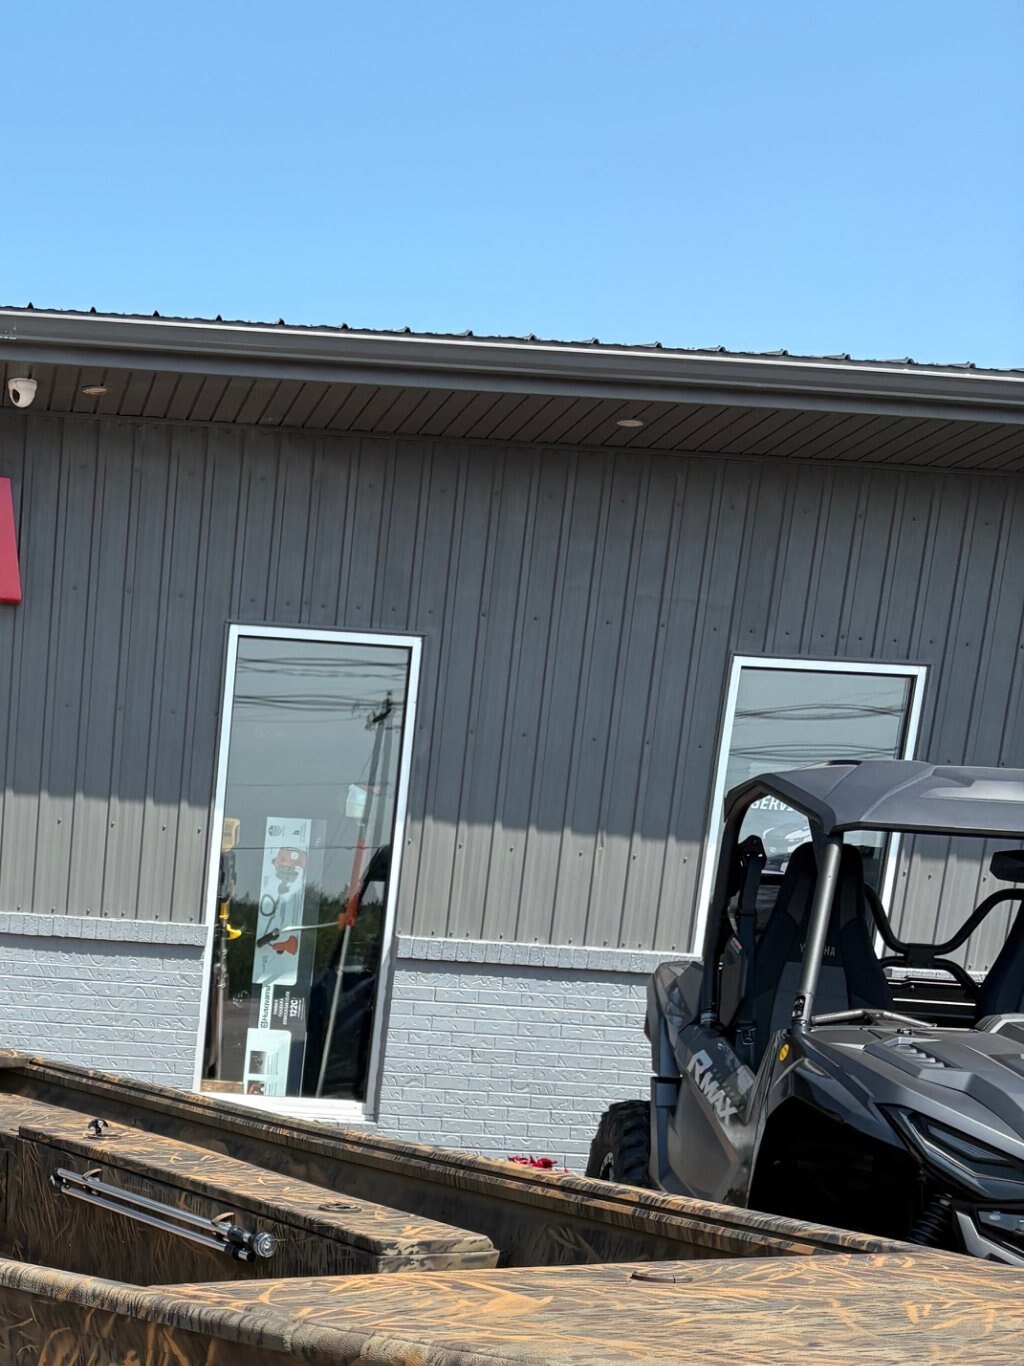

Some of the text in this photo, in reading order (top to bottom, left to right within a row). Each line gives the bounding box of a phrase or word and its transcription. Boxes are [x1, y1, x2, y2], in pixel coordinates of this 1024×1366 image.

[799, 943, 836, 957] YHA
[289, 999, 299, 1017] 122C
[687, 1049, 739, 1125] RMAX
